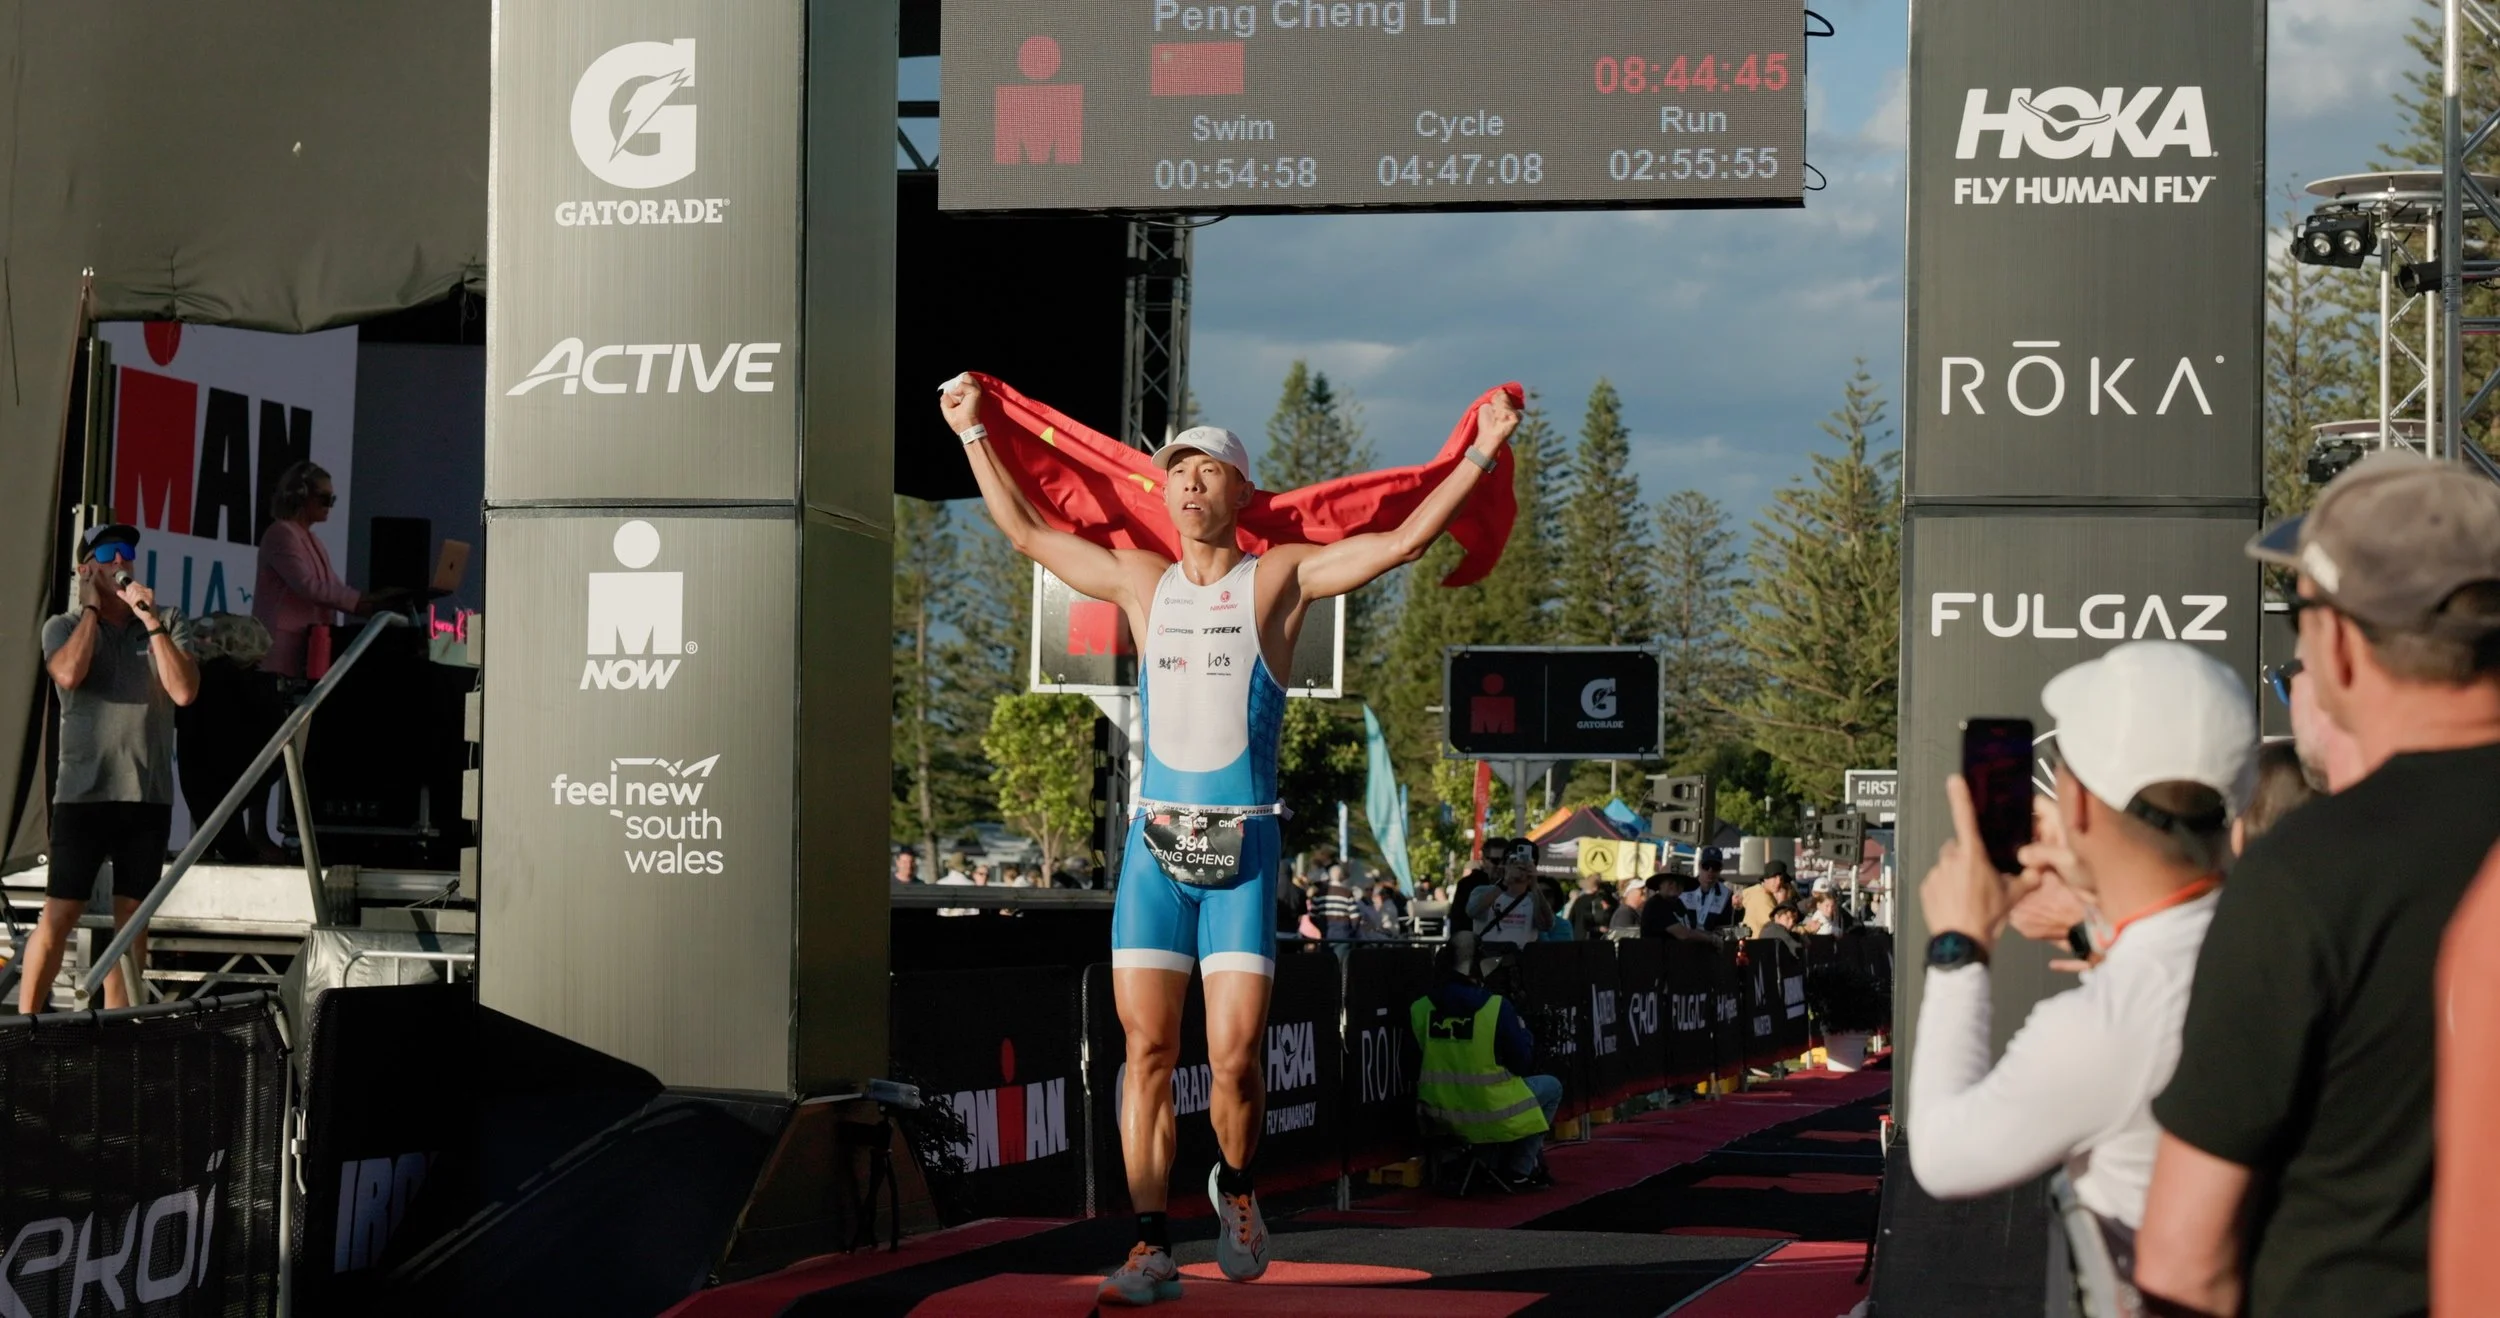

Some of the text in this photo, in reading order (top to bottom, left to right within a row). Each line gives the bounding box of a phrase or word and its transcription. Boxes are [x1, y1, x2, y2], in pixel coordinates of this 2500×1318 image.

[1154, 0, 1256, 37] Peng
[1272, 0, 1404, 34] Cheng
[1594, 52, 1790, 94] 08:44:45
[1193, 114, 1275, 141] Swim
[1416, 110, 1504, 142] Cycle
[1660, 105, 1727, 133] Run
[1955, 86, 2212, 160] HOKA
[1154, 157, 1317, 190] 00:54:58
[1377, 152, 1543, 186] 04:47:08
[1609, 147, 1779, 181] 02:55:55
[1954, 175, 2212, 205] FLY HUMAN FLY
[555, 198, 723, 227] GATORADE
[506, 337, 782, 396] ACTIVE
[112, 364, 313, 548] MAN
[1202, 626, 1242, 635] TREK
[1931, 592, 2228, 641] FULGAZ
[579, 659, 681, 691] NOW
[1576, 720, 1625, 729] GATORADE
[551, 772, 704, 806] feel new
[1858, 780, 1897, 795] FIRST
[624, 808, 723, 840] south
[624, 842, 724, 875] wales
[1174, 834, 1209, 852] 394
[1186, 852, 1235, 867] CHENG
[1266, 1021, 1316, 1092] HOKA
[1170, 1063, 1211, 1117] ORAD
[920, 1076, 1067, 1174] ONMAN
[1278, 1104, 1304, 1133] HUMAN
